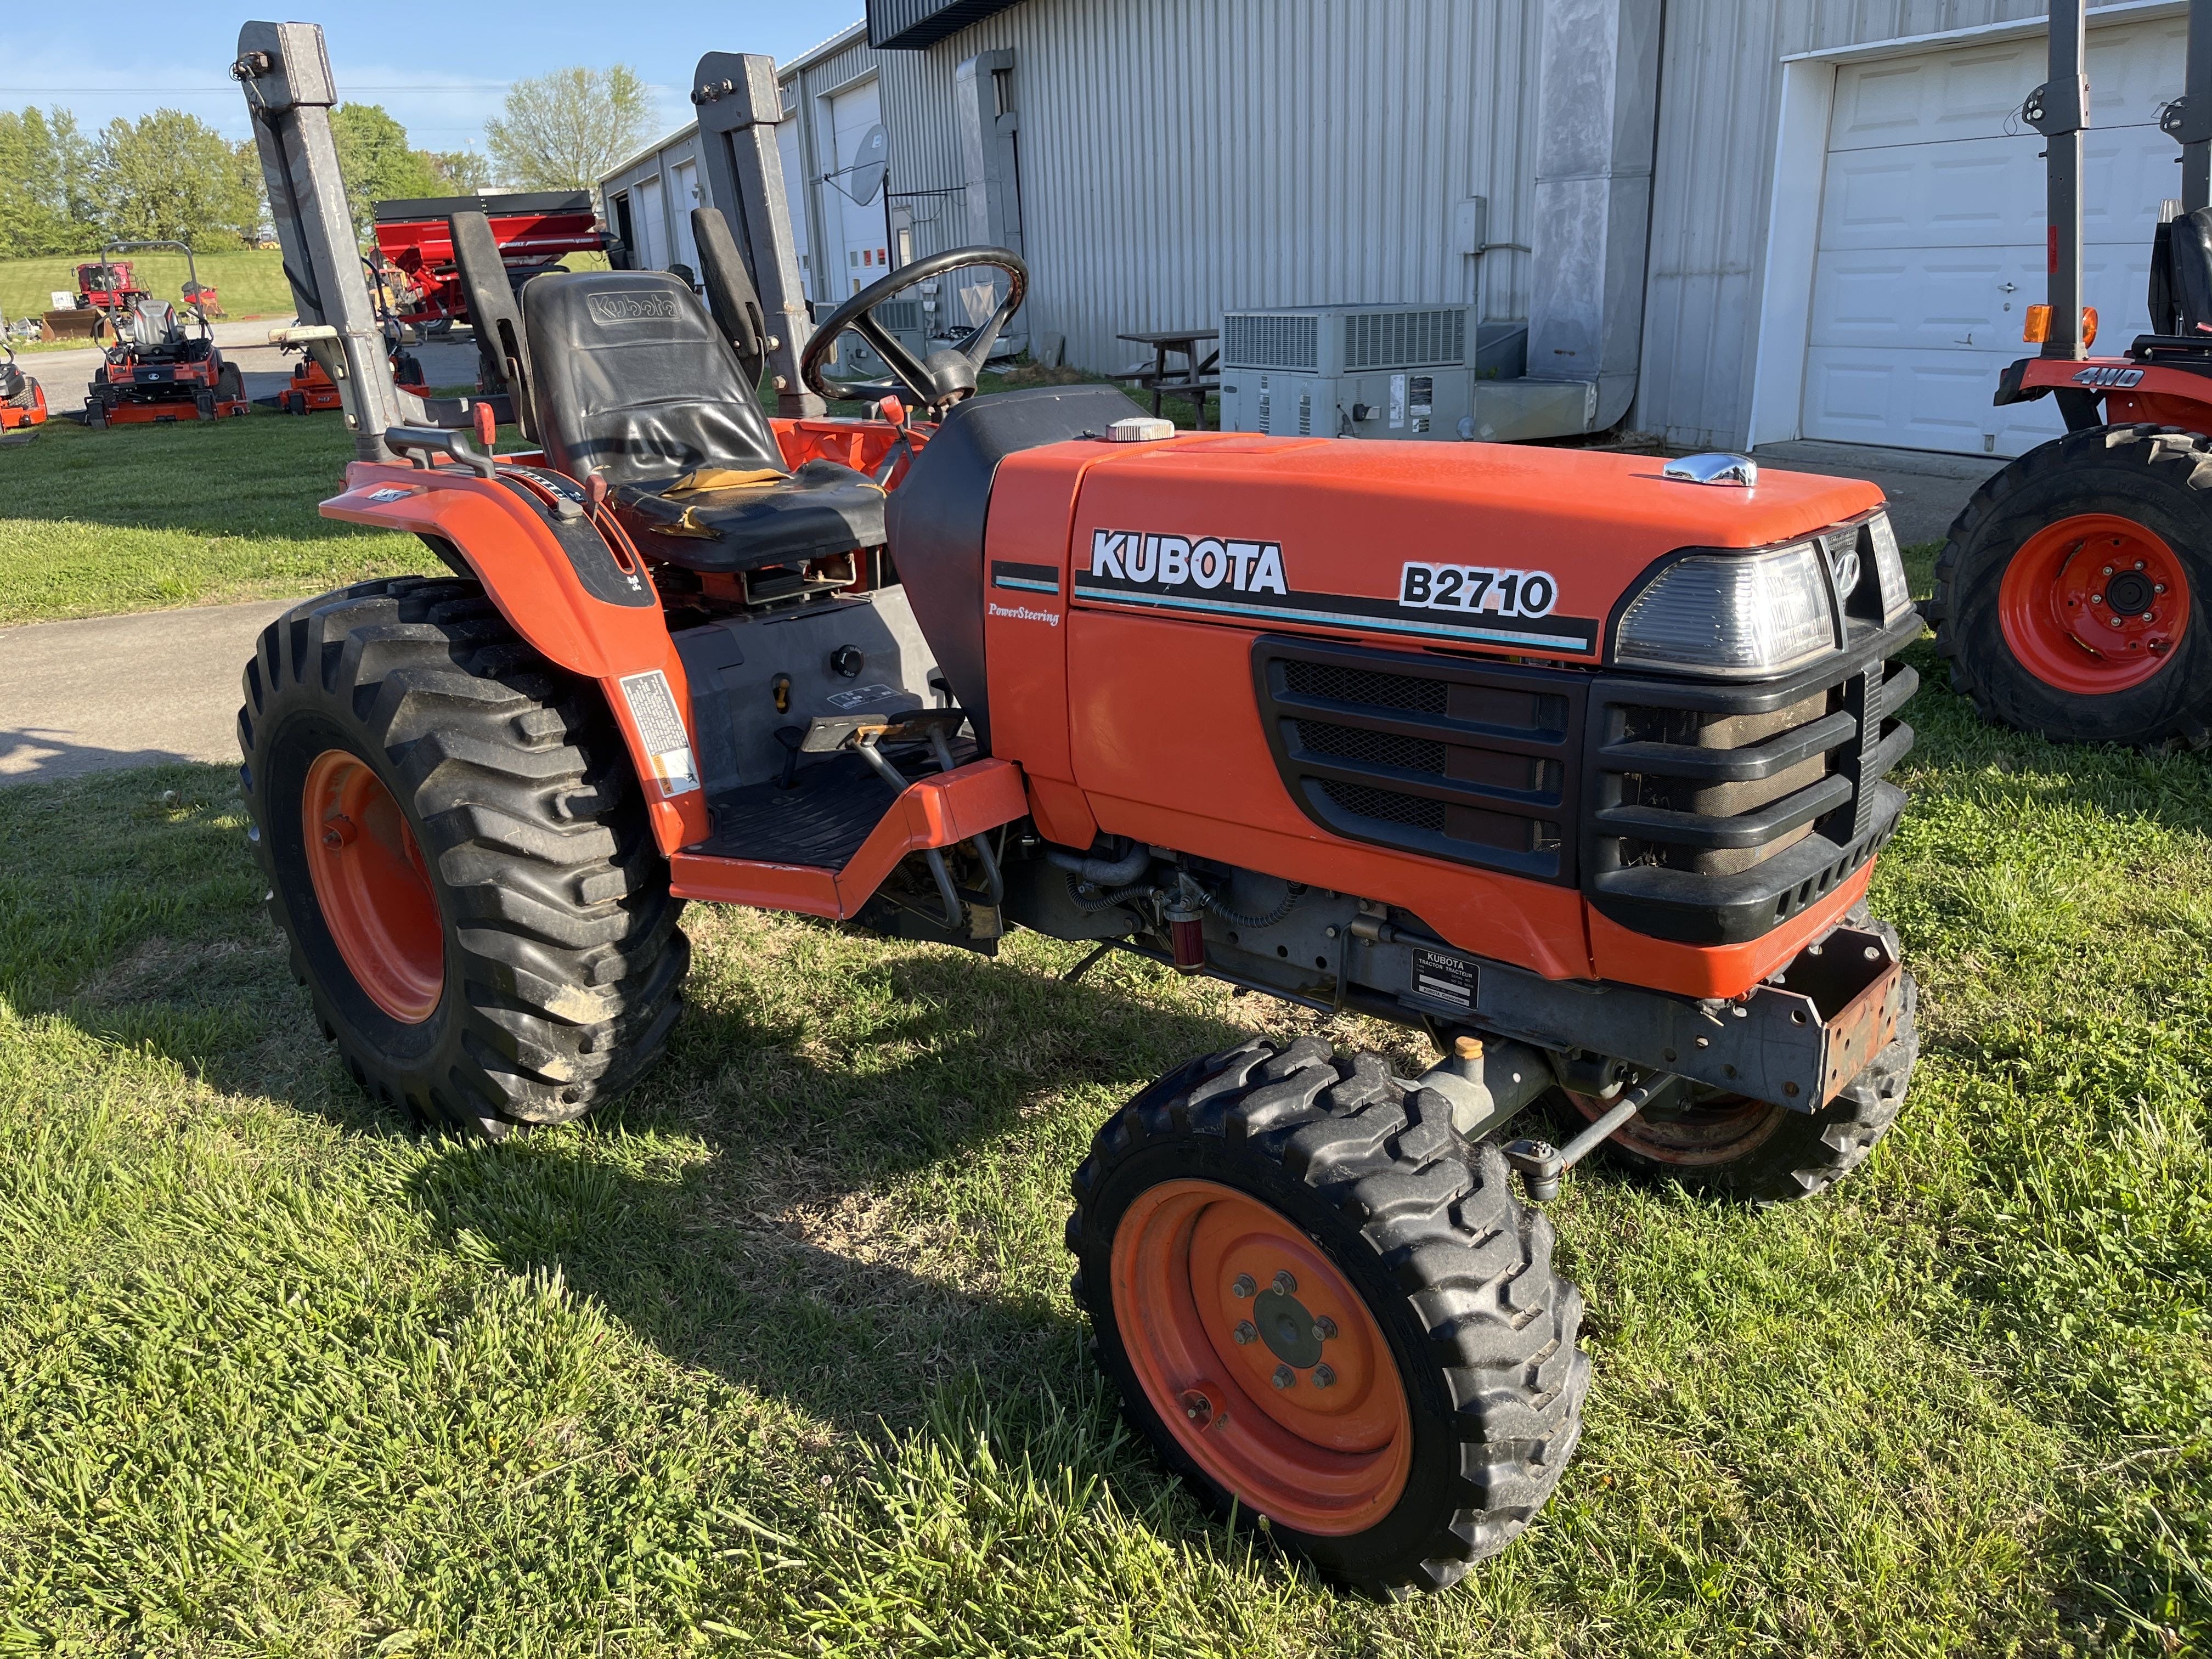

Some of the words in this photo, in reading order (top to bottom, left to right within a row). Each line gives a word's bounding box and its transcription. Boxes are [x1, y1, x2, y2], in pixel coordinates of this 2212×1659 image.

[591, 294, 678, 319] Kubota
[2072, 366, 2145, 387] 4WD
[1092, 533, 1287, 595] KUBOTA
[1403, 565, 1555, 615] B2710
[1419, 958, 1443, 969] TRACTOR
[1446, 966, 1472, 978] TRACTEUR
[1427, 952, 1464, 970] KUBOTA
[1424, 988, 1440, 996] KUBOTA
